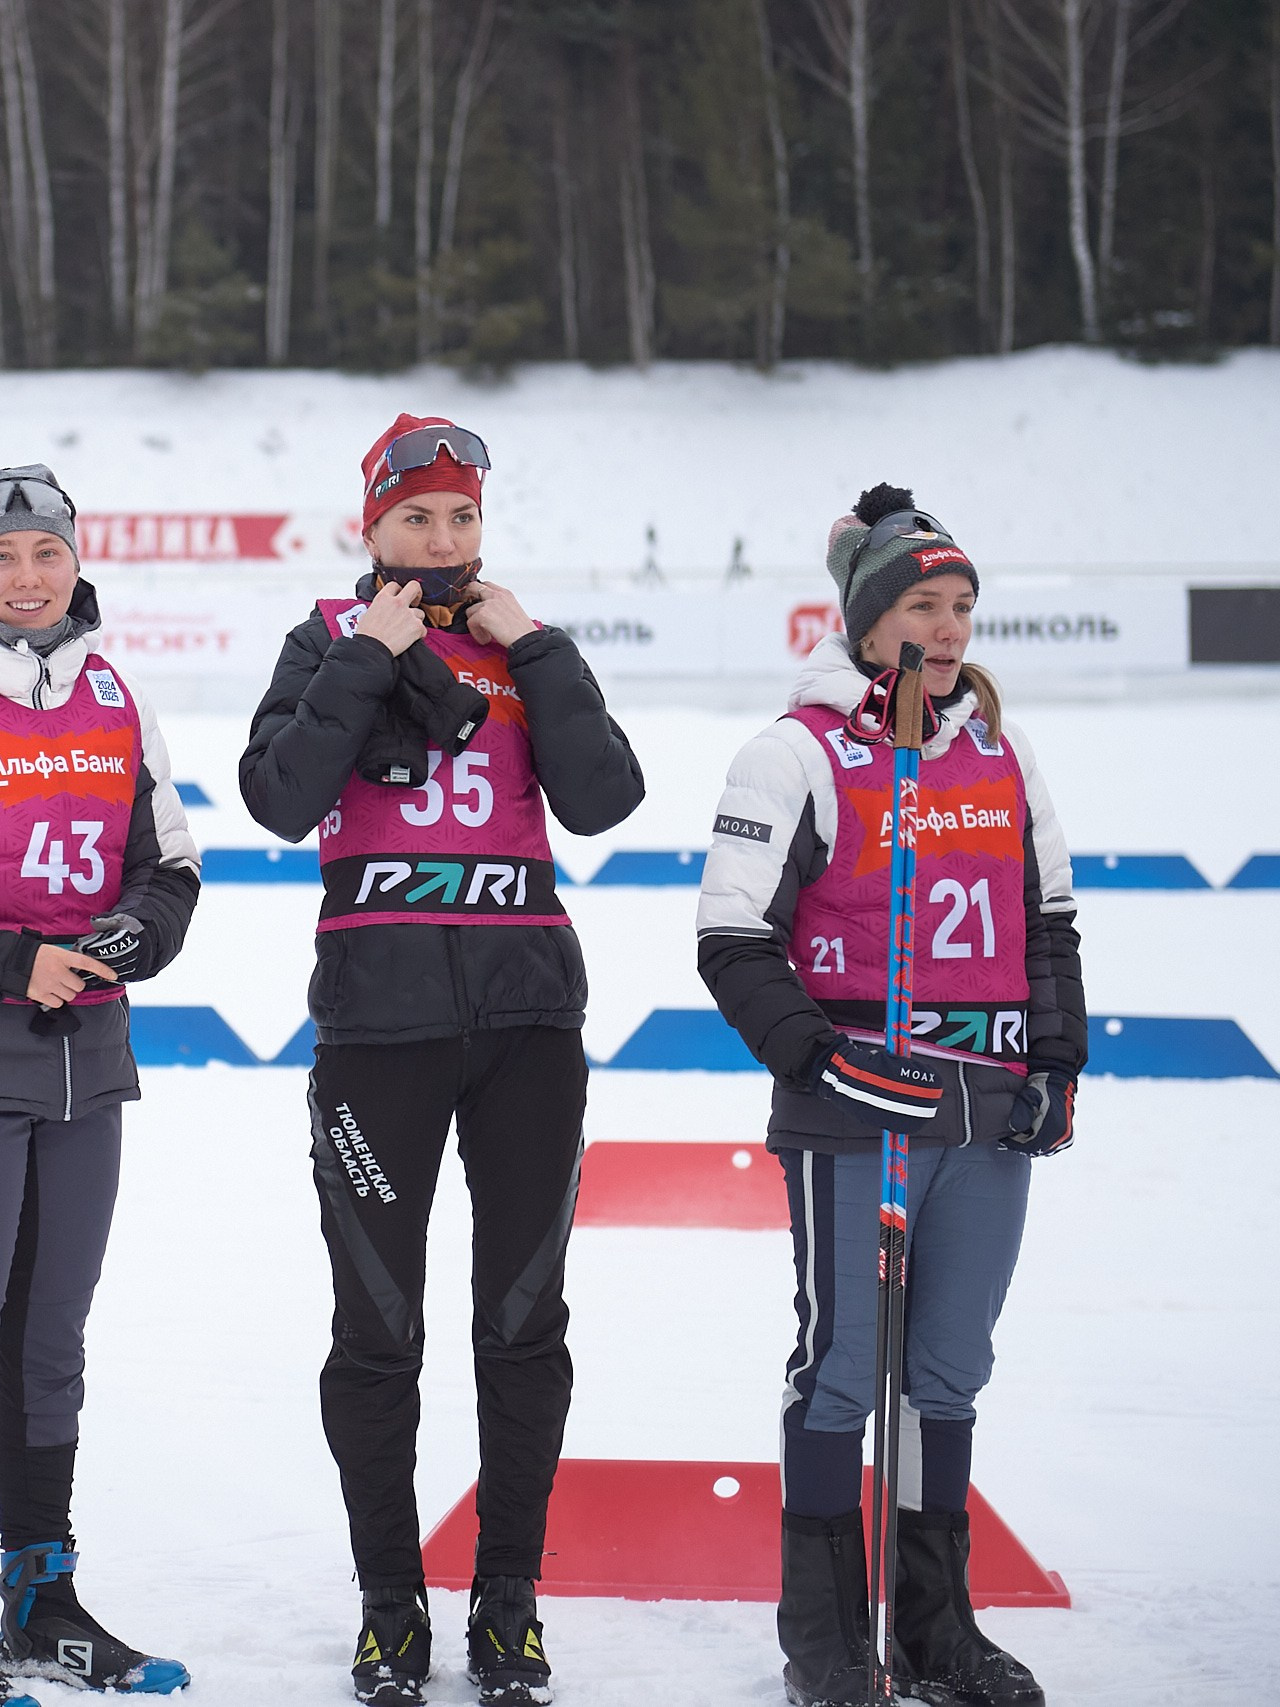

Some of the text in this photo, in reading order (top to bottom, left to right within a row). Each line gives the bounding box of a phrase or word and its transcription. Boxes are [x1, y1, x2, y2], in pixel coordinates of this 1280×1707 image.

[95, 680, 117, 691] 2024
[99, 690, 120, 702] 2025
[71, 749, 126, 776] Банк
[399, 750, 494, 828] 35
[720, 818, 762, 838] MOAX
[880, 804, 1011, 837] Аьфа Банк
[20, 820, 105, 895] 43
[354, 861, 528, 907] PARI
[928, 878, 995, 960] 21
[98, 935, 134, 957] MOAX
[810, 936, 845, 974] 21
[900, 1067, 935, 1083] MOAX
[329, 1126, 371, 1198] ОБЛАСТЬ
[335, 1102, 397, 1204] ТЮМЕНСКАЯ
